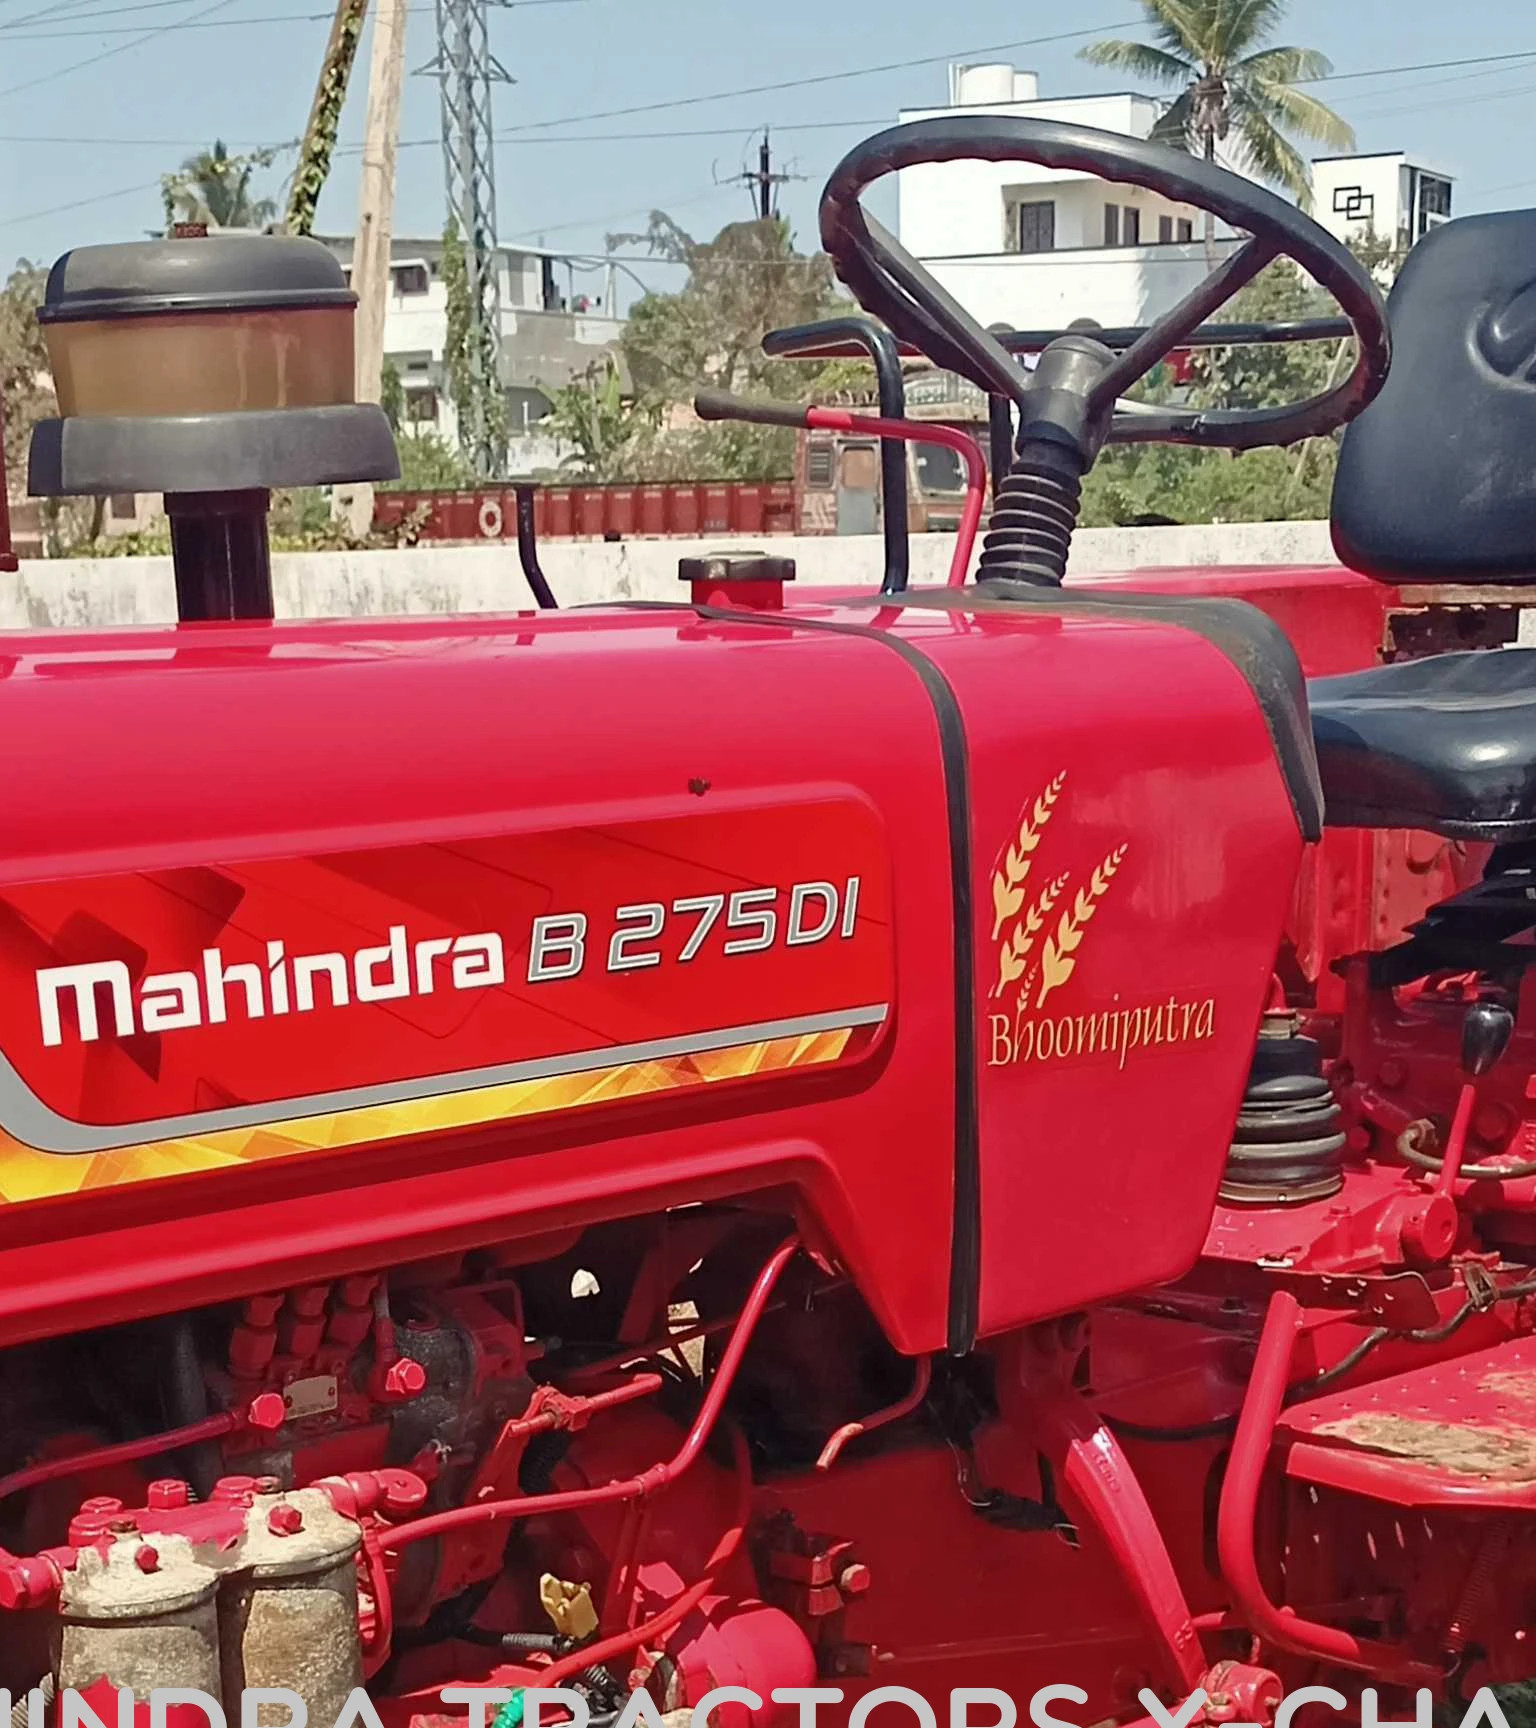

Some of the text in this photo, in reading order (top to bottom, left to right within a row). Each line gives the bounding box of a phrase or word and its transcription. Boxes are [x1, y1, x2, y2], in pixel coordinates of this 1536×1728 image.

[35, 924, 506, 1046] Mahindra
[525, 911, 587, 984] B
[987, 993, 1215, 1071] Bhoomiputra
